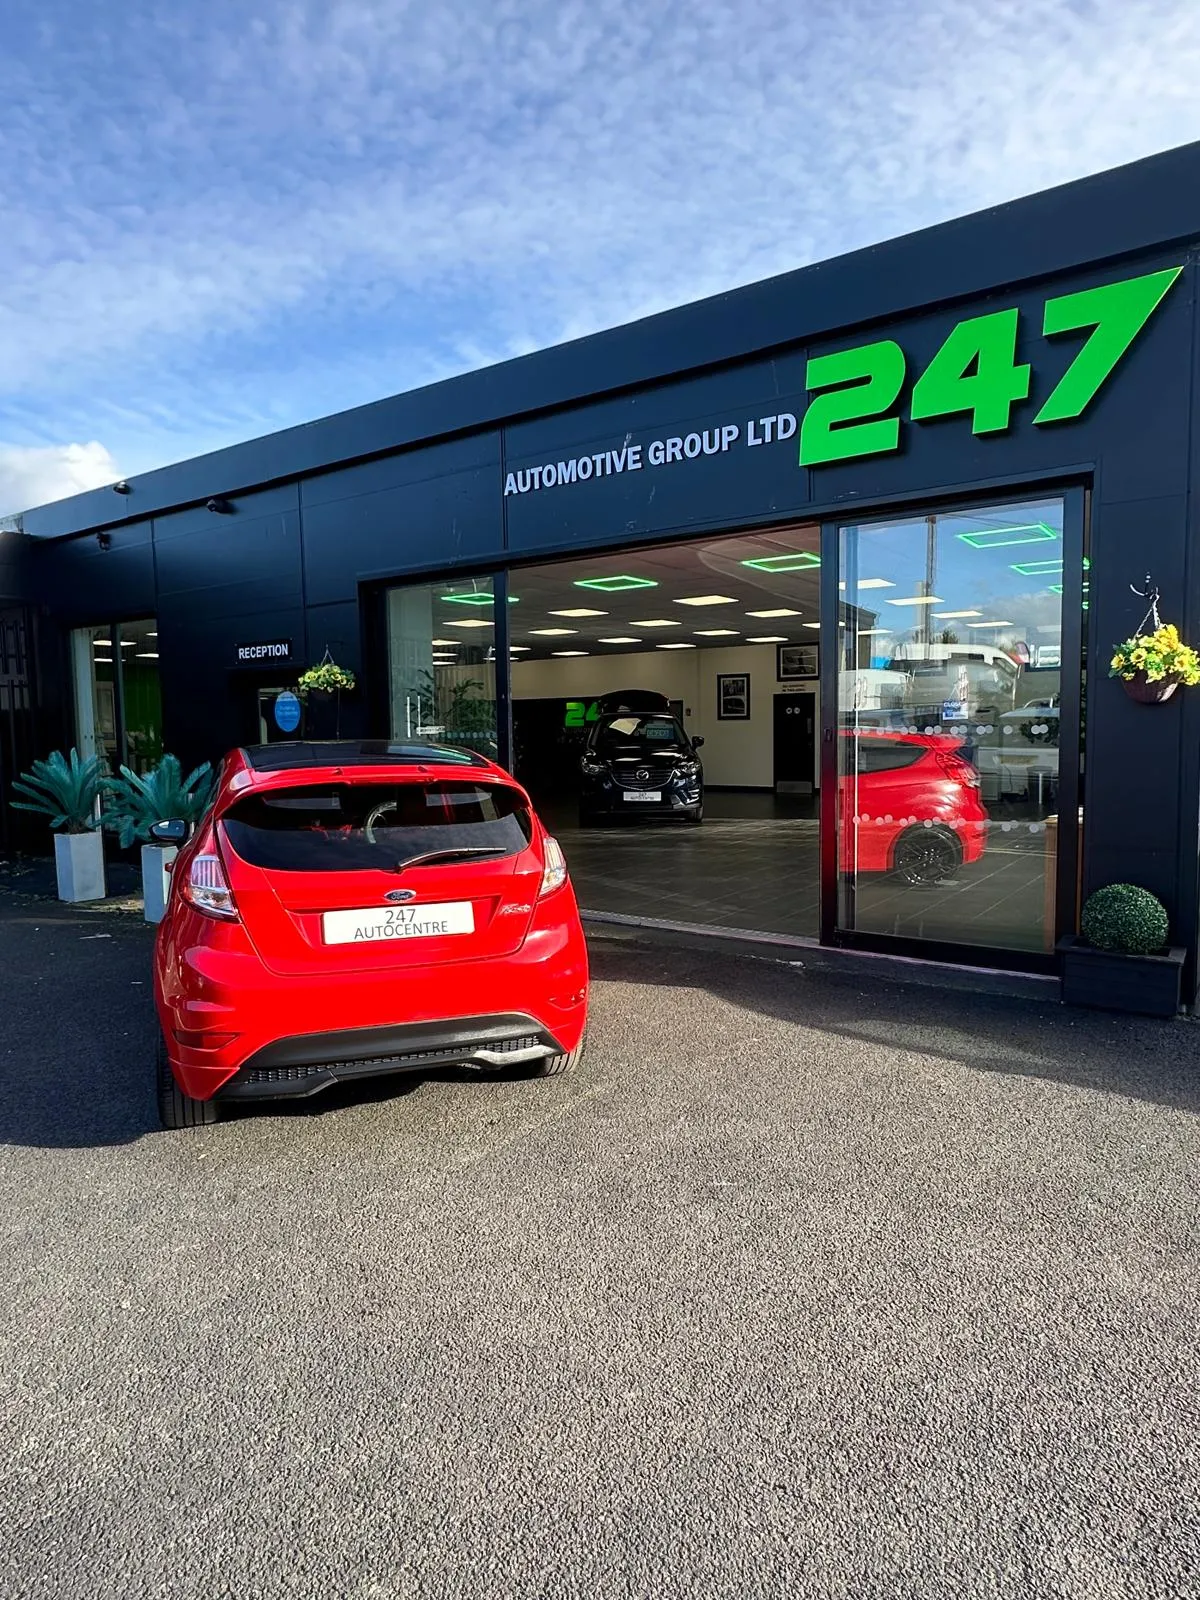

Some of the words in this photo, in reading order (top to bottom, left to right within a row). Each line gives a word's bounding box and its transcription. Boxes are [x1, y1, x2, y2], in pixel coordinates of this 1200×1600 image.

[799, 266, 1184, 466] 247
[503, 445, 643, 497] AUTOMOTIVE
[648, 424, 739, 466] GROUP
[747, 412, 797, 448] LTD
[238, 643, 289, 660] RECEPTION
[385, 908, 416, 925] 247
[354, 920, 449, 940] AUTOCENTRE
